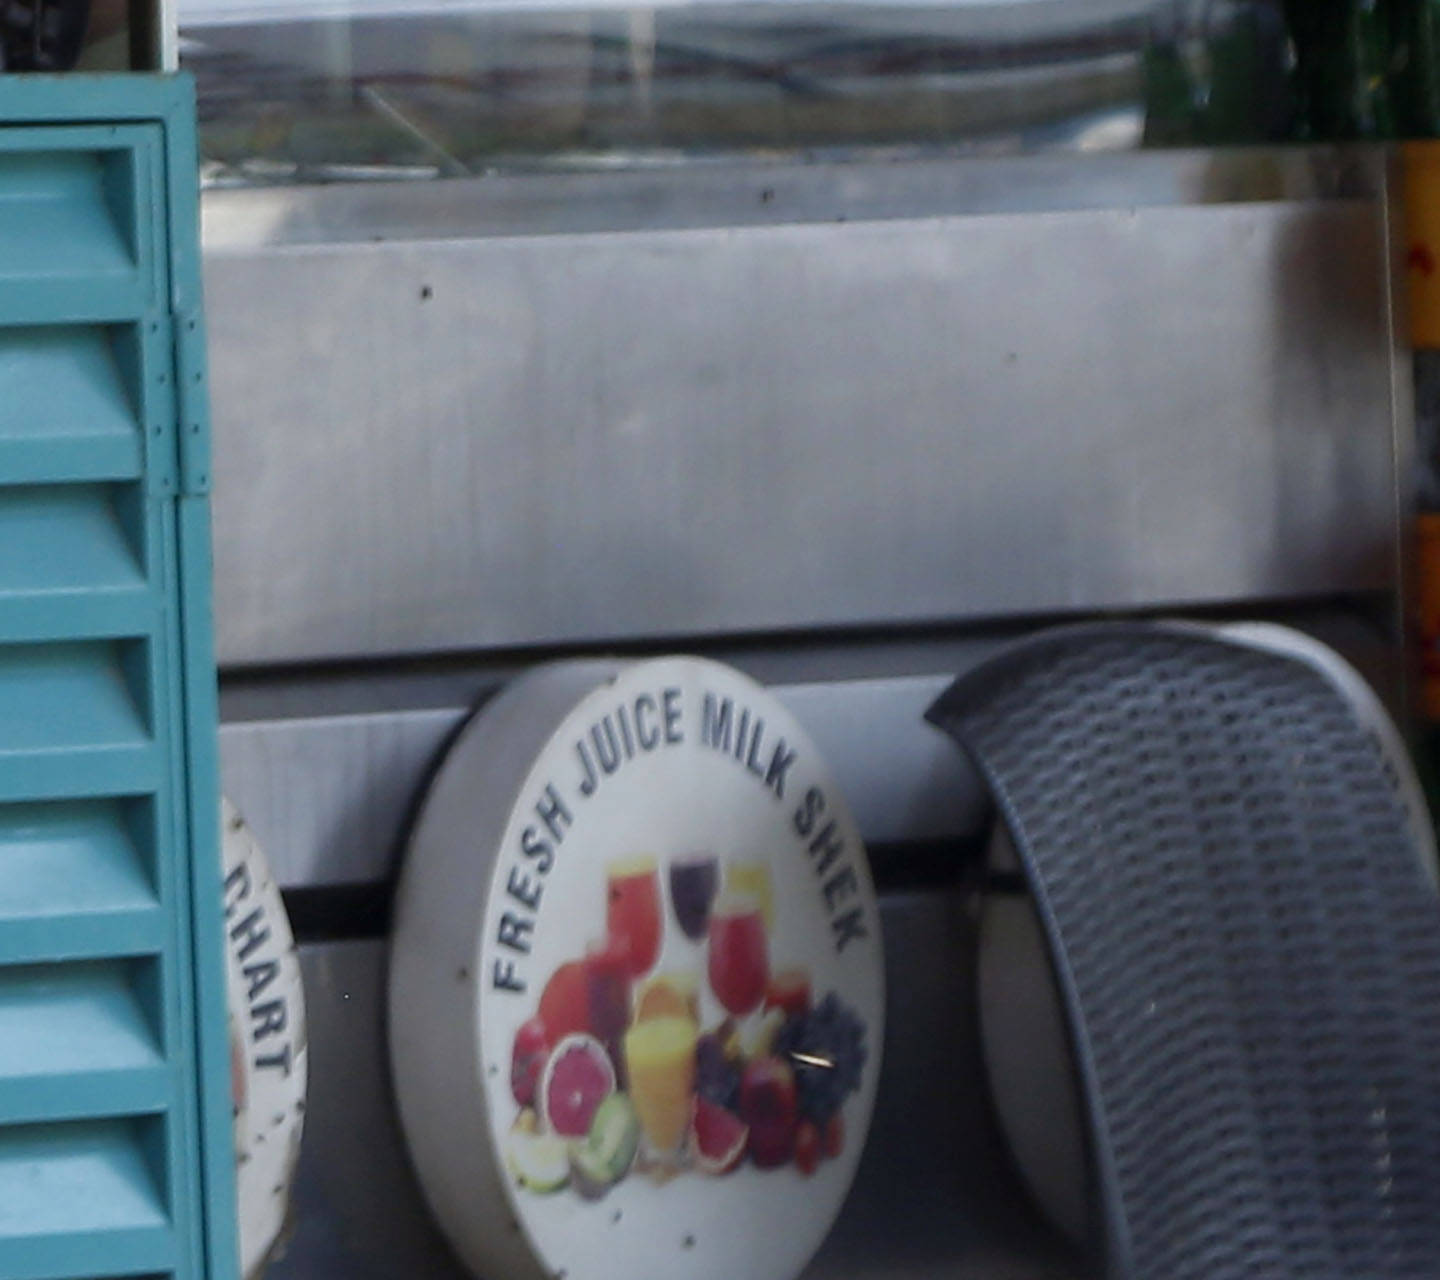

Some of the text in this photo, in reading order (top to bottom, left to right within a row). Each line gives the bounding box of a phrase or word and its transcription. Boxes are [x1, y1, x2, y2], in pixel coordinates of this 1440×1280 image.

[491, 688, 872, 994] FRESH JUICE MILK SHEK
